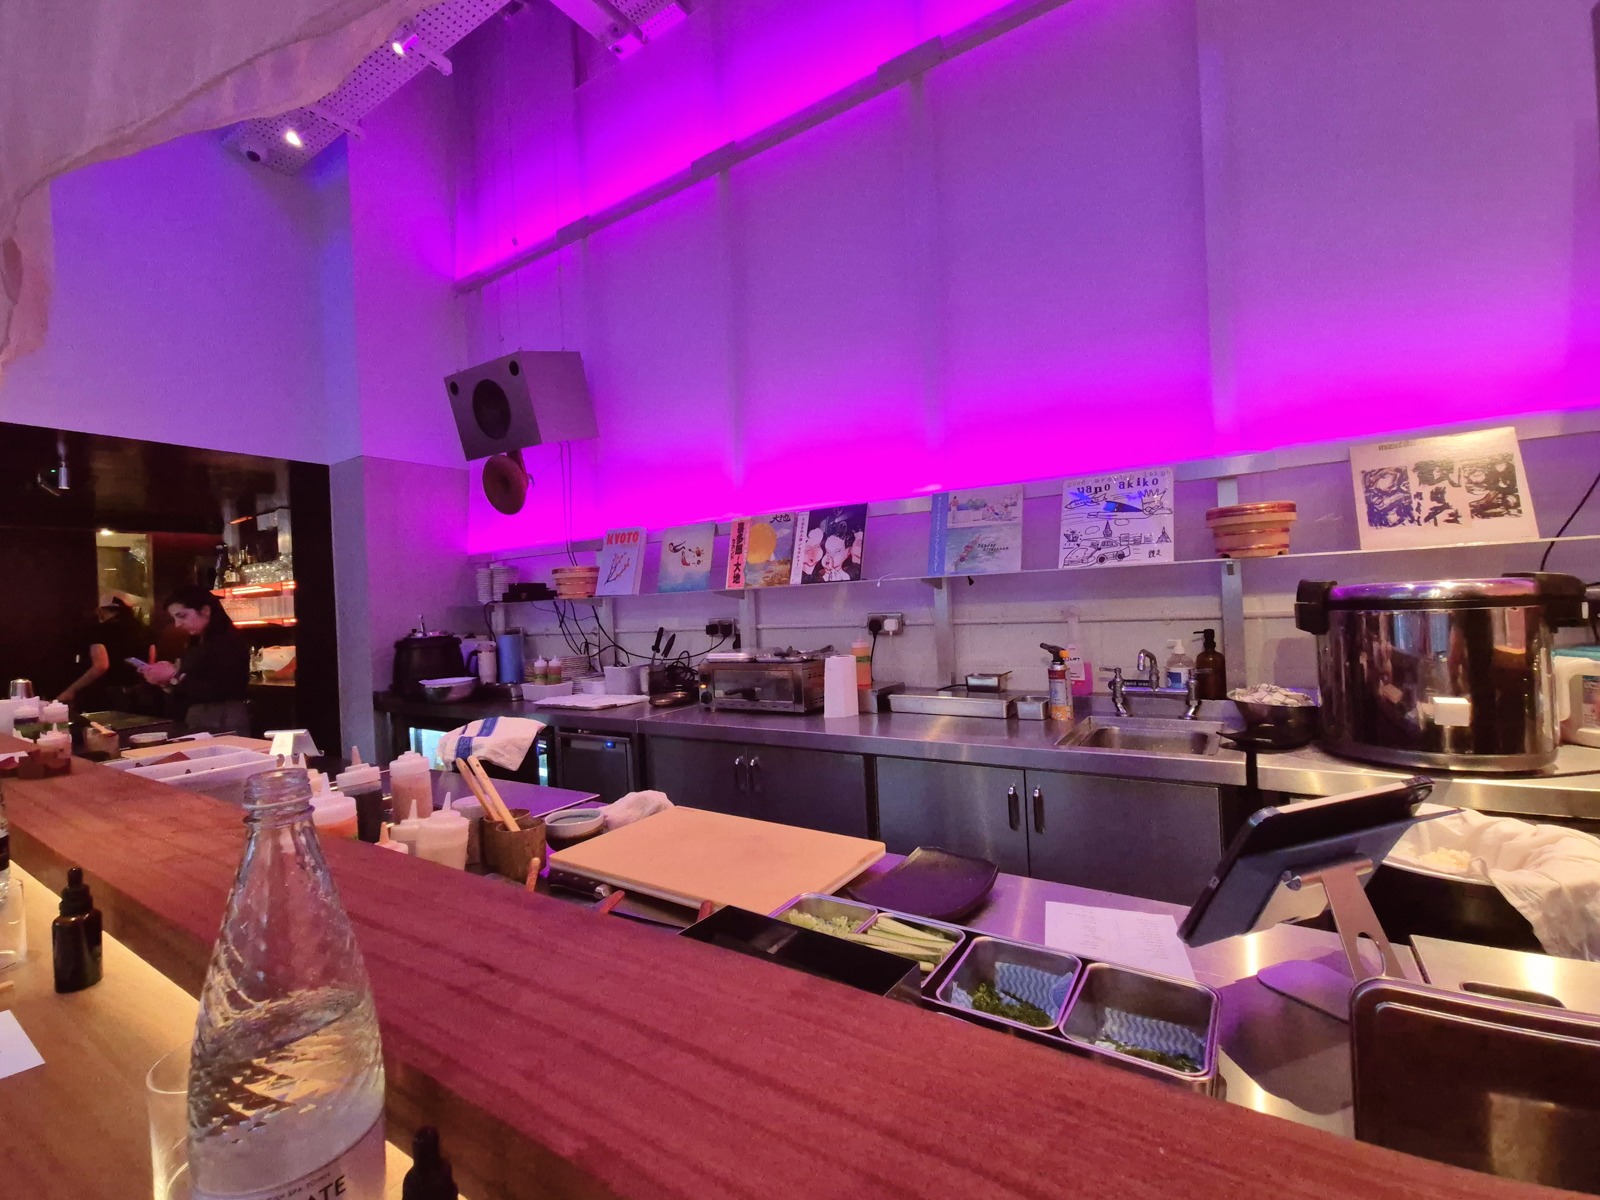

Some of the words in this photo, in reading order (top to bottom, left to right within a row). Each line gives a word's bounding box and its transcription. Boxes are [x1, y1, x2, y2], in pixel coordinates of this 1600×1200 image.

[1076, 483, 1111, 495] yano
[1118, 477, 1159, 490] akiko
[769, 513, 791, 524] 大地
[606, 531, 640, 545] KYOTO
